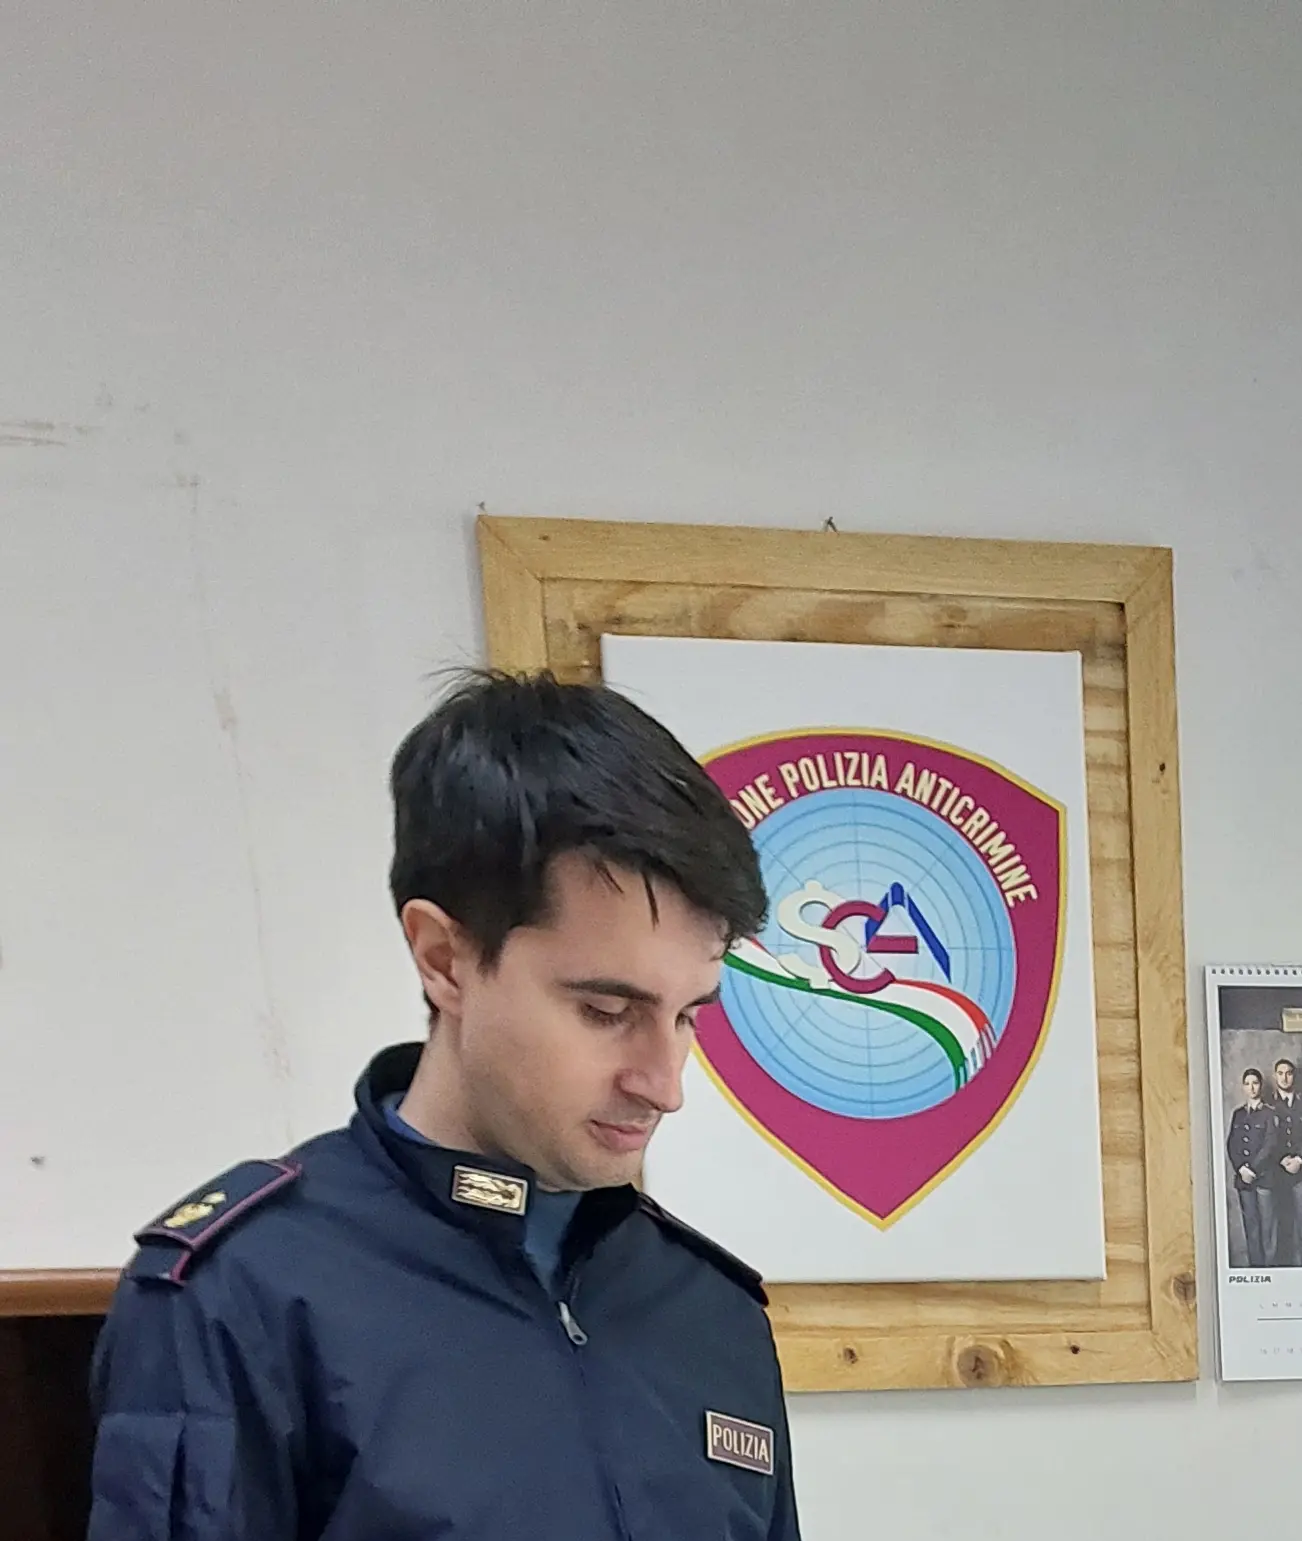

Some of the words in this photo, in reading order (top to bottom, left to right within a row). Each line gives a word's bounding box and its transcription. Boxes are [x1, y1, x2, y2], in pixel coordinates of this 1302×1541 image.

[778, 752, 889, 798] POLIZIA
[894, 763, 1038, 909] ANTICRIMINE
[1229, 1275, 1271, 1284] POLIZIA
[713, 1423, 769, 1463] POLIZIA
